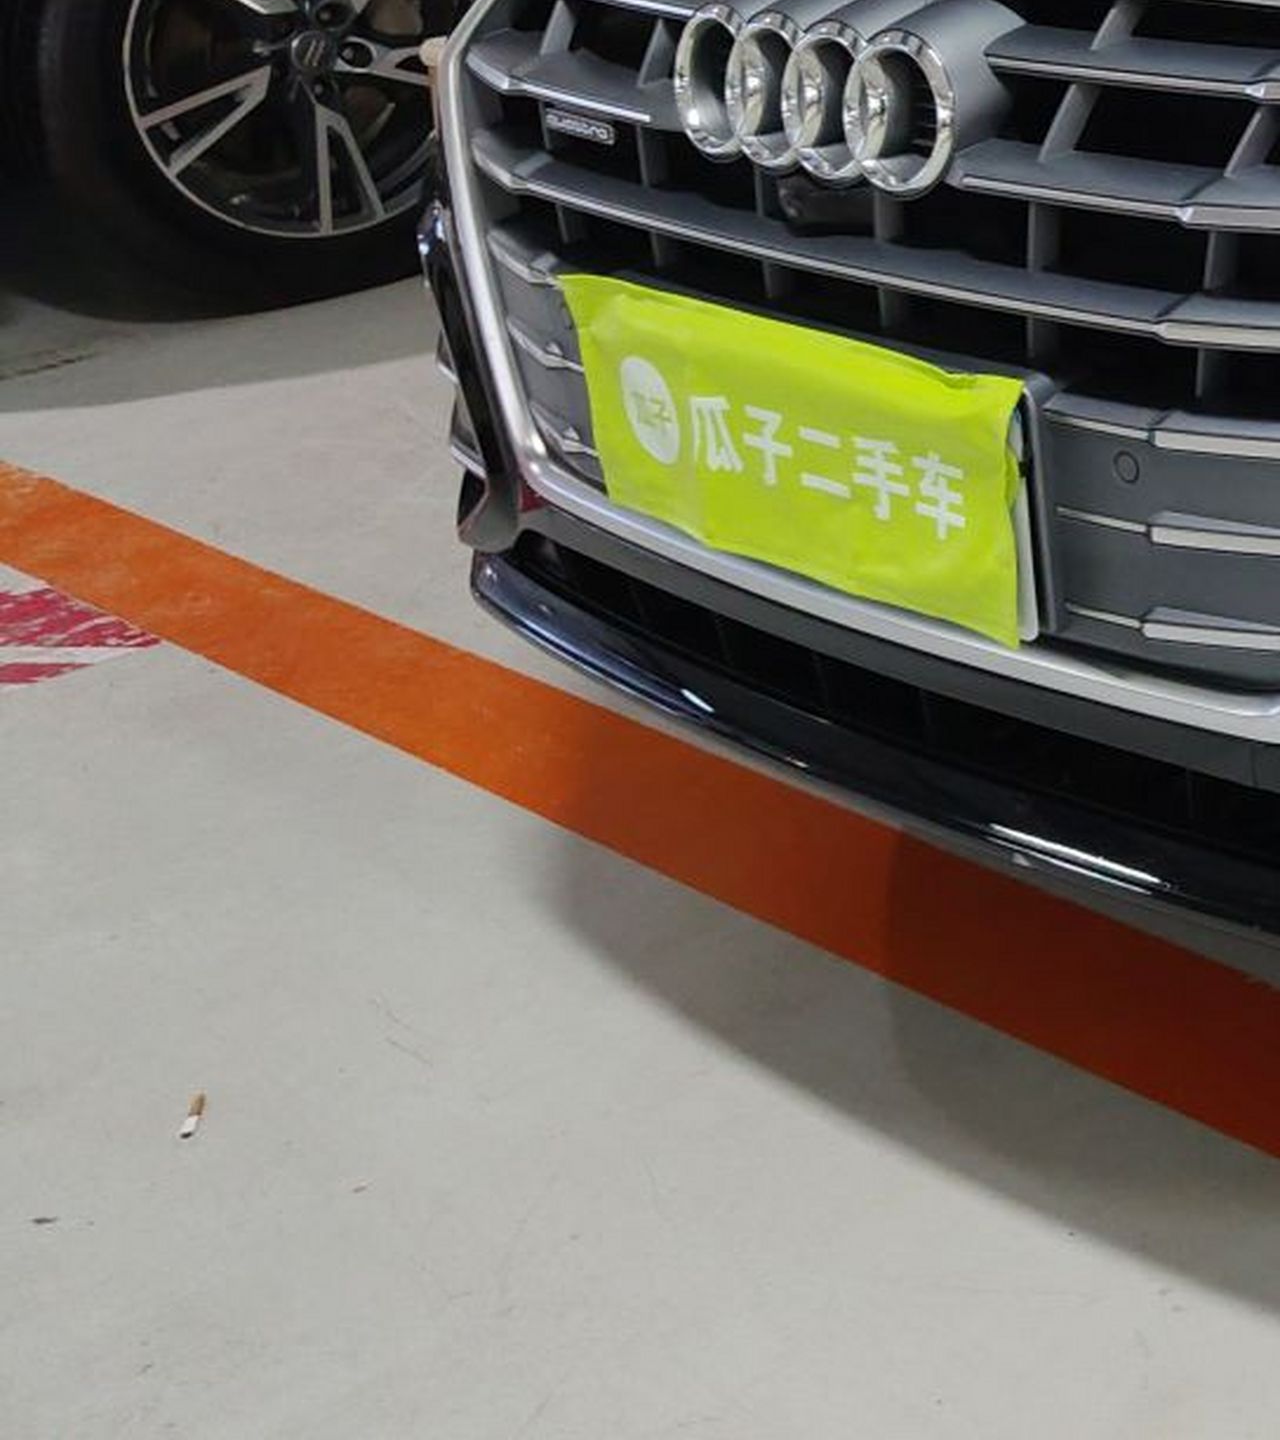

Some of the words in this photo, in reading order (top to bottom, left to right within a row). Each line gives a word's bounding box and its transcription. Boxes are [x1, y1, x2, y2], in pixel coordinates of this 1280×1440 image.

[689, 395, 967, 540] 瓜子二手车
